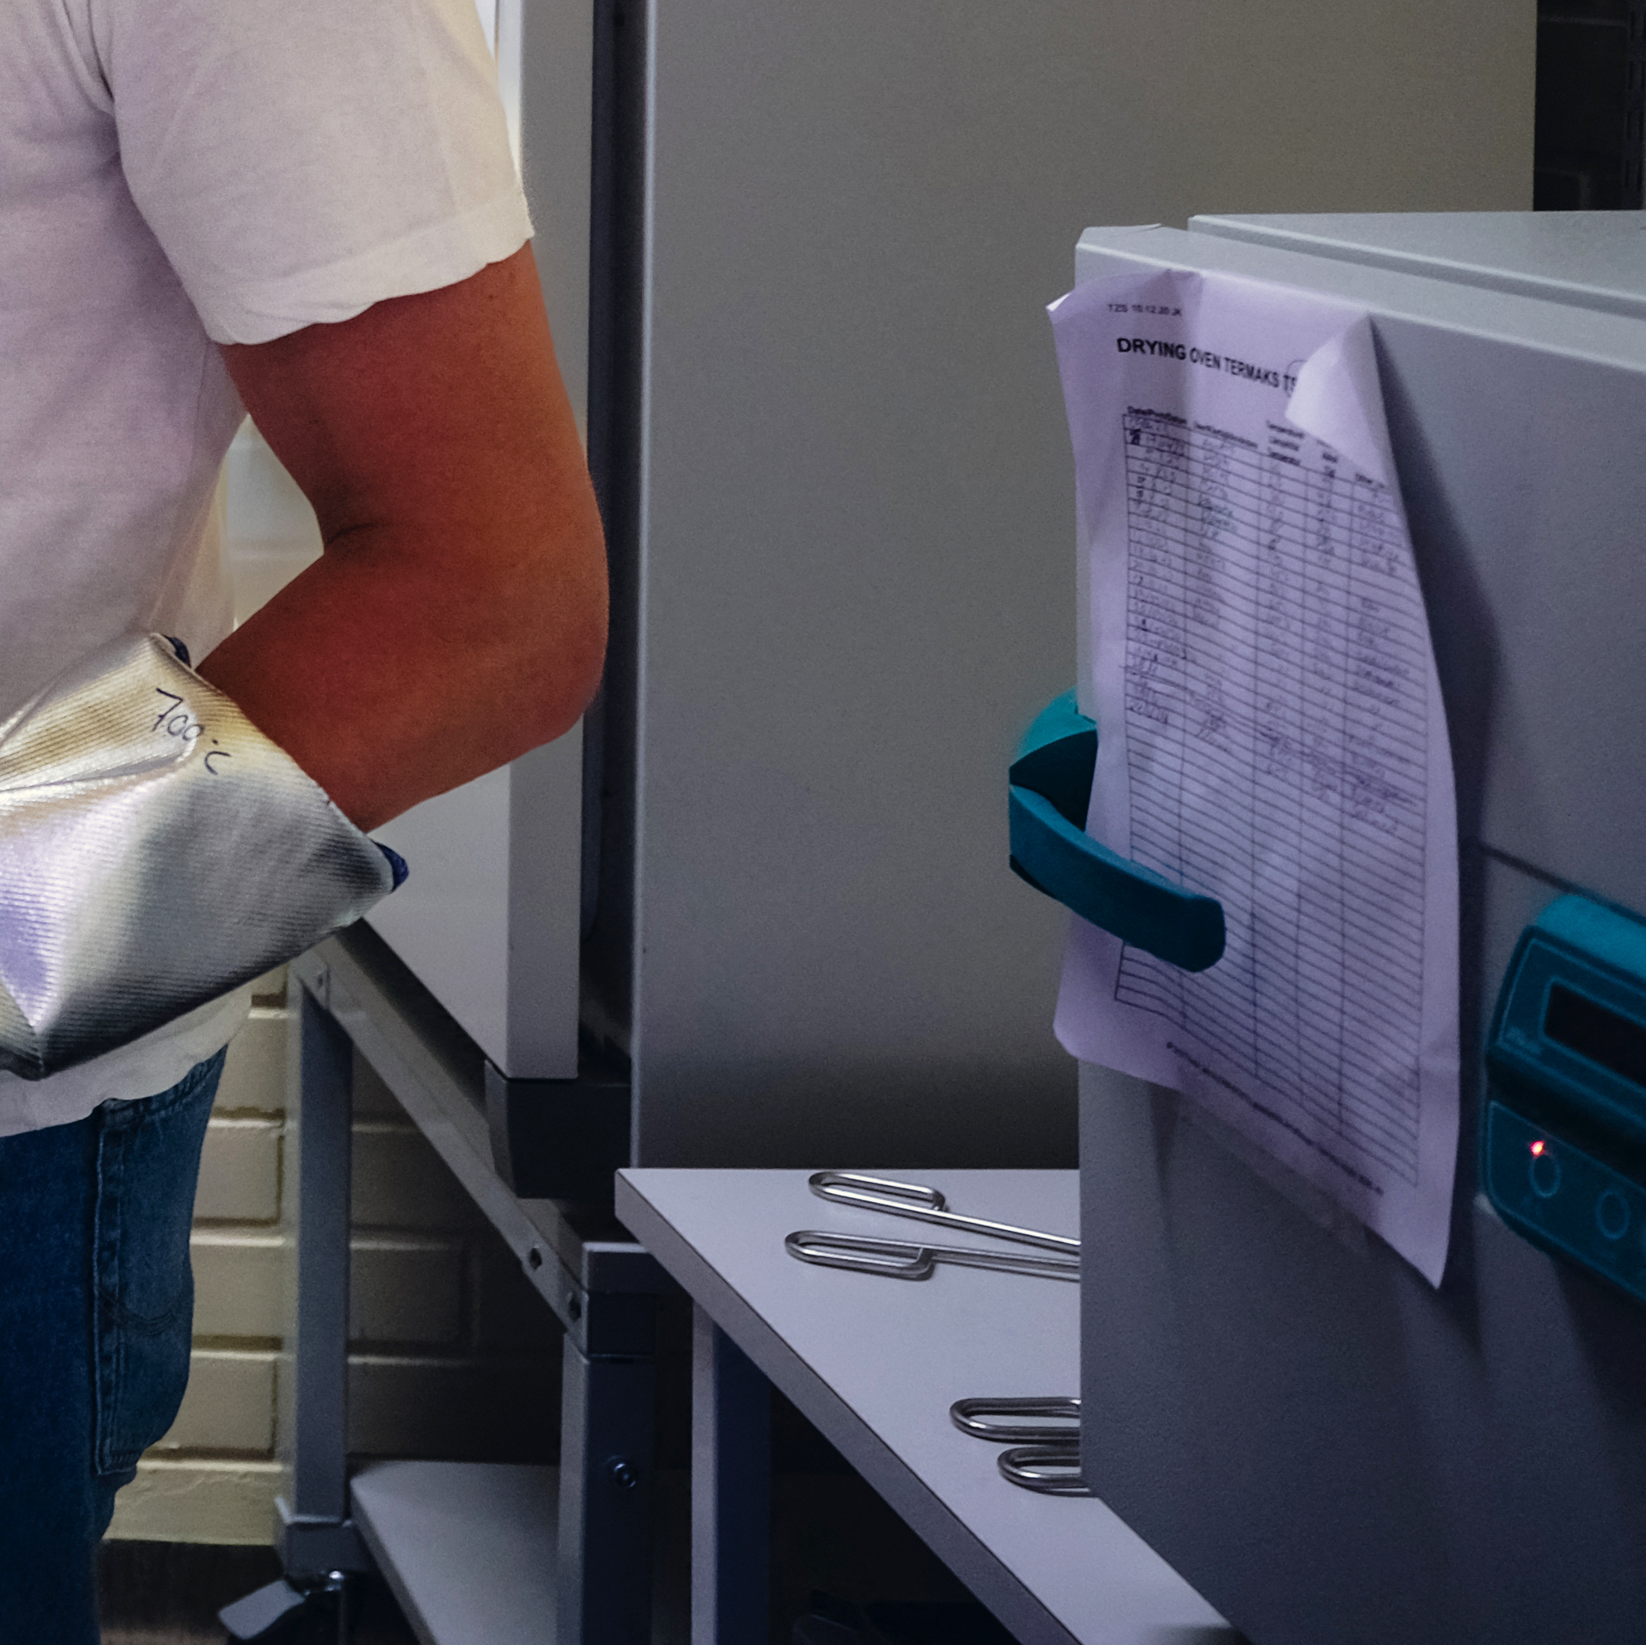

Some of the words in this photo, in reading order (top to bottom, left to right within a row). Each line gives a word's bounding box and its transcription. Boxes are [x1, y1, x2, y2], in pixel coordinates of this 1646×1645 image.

[1117, 338, 1186, 361] DRYING
[1189, 347, 1220, 371] OVEN
[1223, 356, 1279, 388] TERMAKS
